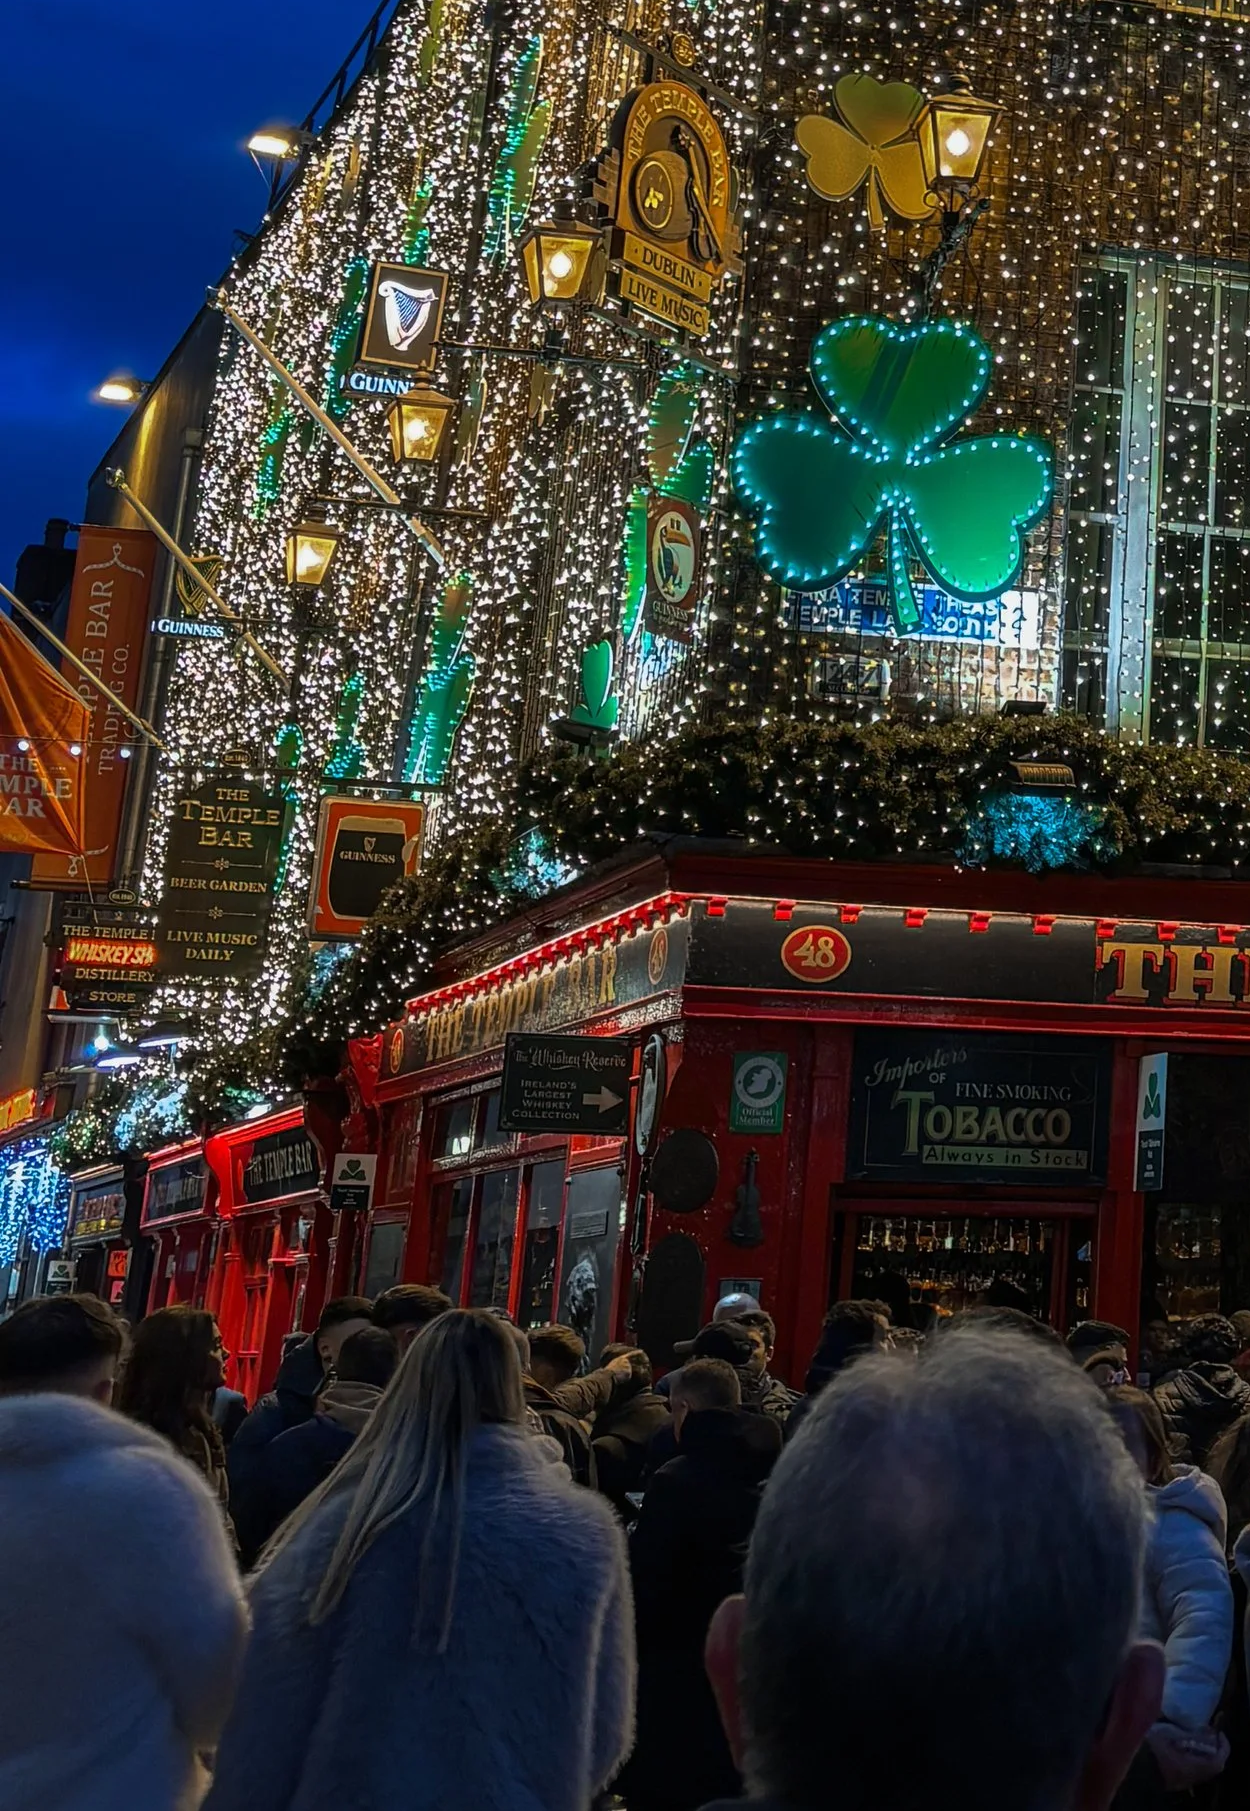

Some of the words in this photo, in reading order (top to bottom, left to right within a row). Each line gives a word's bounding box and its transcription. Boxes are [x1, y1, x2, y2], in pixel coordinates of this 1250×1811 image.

[627, 104, 652, 160] THE
[649, 89, 714, 144] TEMPLE
[711, 146, 726, 207] BAR
[643, 245, 697, 289] DUBLIN
[628, 277, 658, 309] LIVE
[660, 294, 704, 329] MUSIC
[349, 372, 411, 394] GUINN
[86, 580, 114, 639] BAR
[158, 618, 225, 638] GUINNESS
[0, 774, 73, 799] MPLE
[216, 788, 249, 803] THE
[179, 799, 281, 827] TEMPLE
[198, 826, 254, 849] BAR
[340, 850, 396, 864] GUINNESS
[170, 876, 207, 890] BEER
[208, 879, 268, 893] GARDEN
[62, 924, 91, 937] THE
[93, 926, 149, 940] TEMPLE
[167, 930, 204, 942] LIVE
[206, 932, 258, 947] MUSIC
[69, 941, 131, 965] WHISKEY
[185, 947, 234, 962] DAILY
[793, 933, 837, 968] 48
[75, 968, 155, 982] DISTILLERY
[88, 991, 137, 1003] STORE
[521, 1079, 577, 1090] IRELAND'S
[928, 1071, 947, 1085] OF
[523, 1090, 573, 1100] LARGEST
[955, 1081, 993, 1100] FINE
[996, 1082, 1072, 1103] SMOKING
[522, 1098, 573, 1110] WHISKEY
[511, 1109, 580, 1121] COLLECTION
[739, 1115, 775, 1127] Member
[889, 1090, 1073, 1156] TOBACCO
[925, 1146, 995, 1164] Always
[1005, 1150, 1021, 1164] in
[1030, 1149, 1086, 1167] Stock
